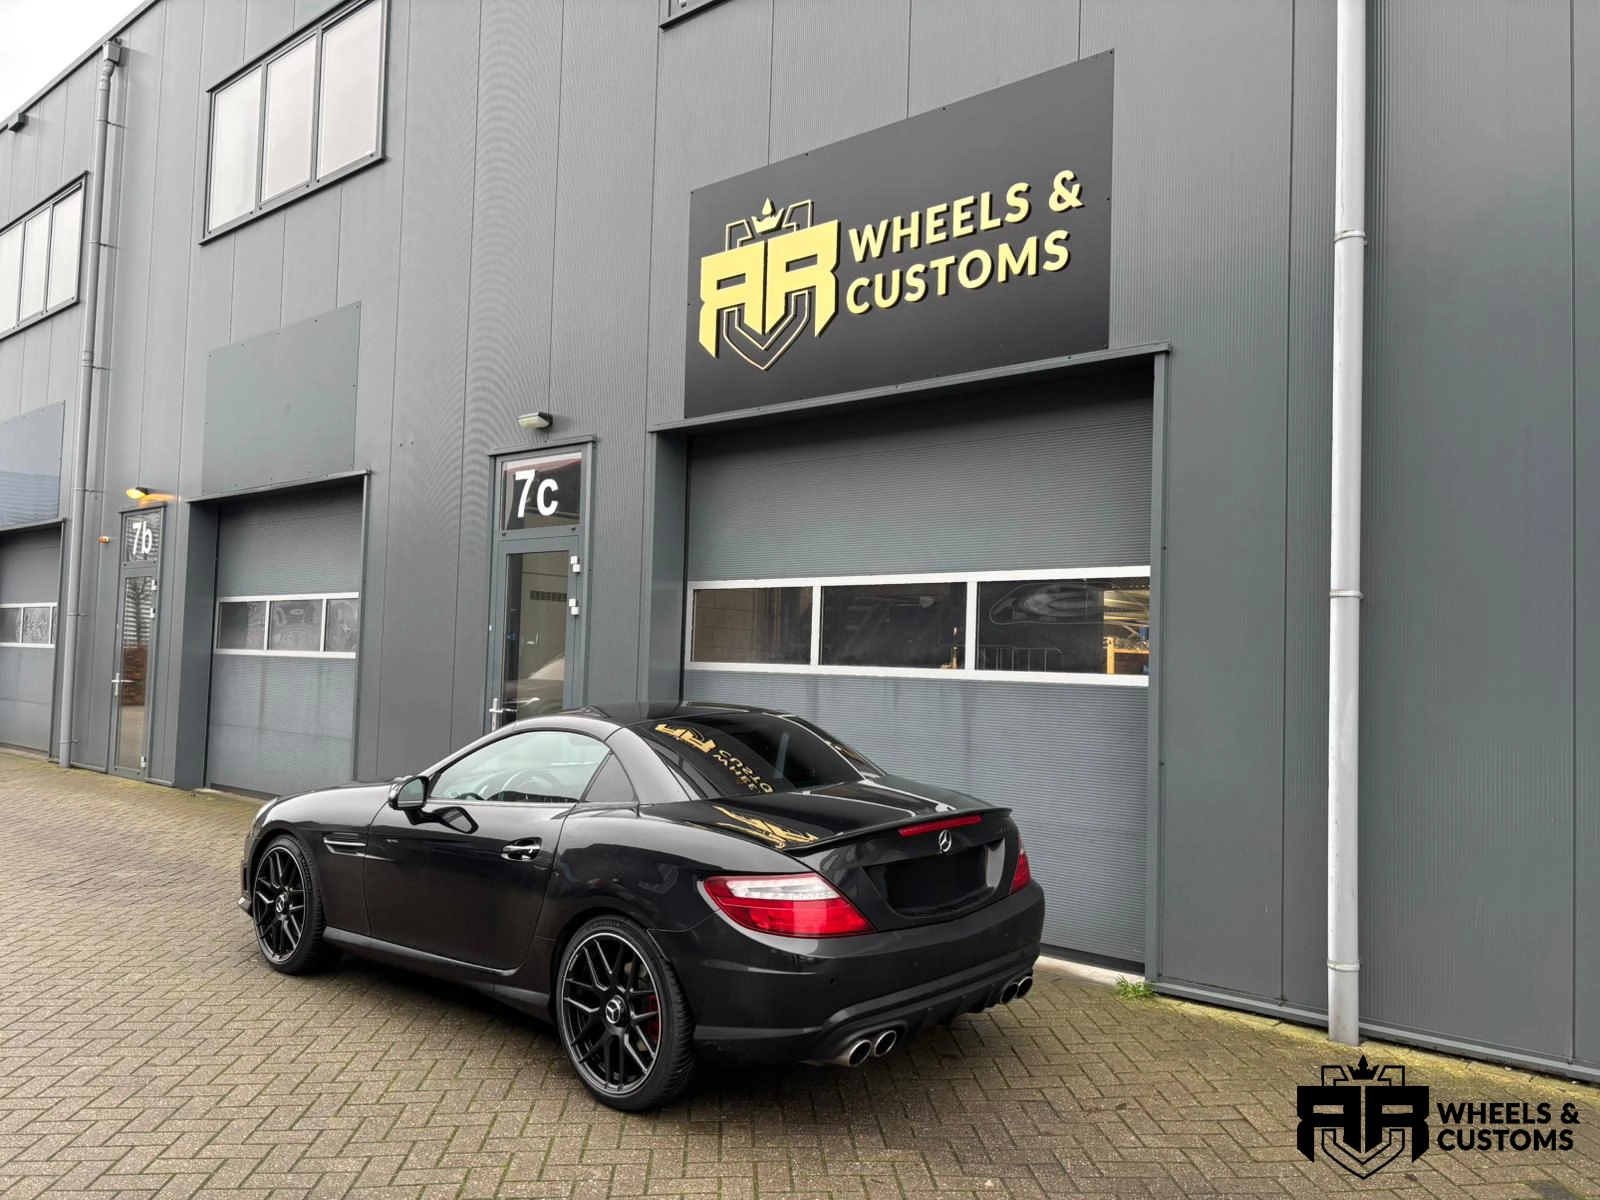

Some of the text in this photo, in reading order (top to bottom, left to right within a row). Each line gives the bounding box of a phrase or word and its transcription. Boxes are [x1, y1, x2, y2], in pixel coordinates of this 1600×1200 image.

[849, 170, 1082, 263] WHEELS &
[846, 230, 1070, 314] CUSTOMS
[515, 469, 559, 518] 7c
[132, 521, 152, 554] 7b
